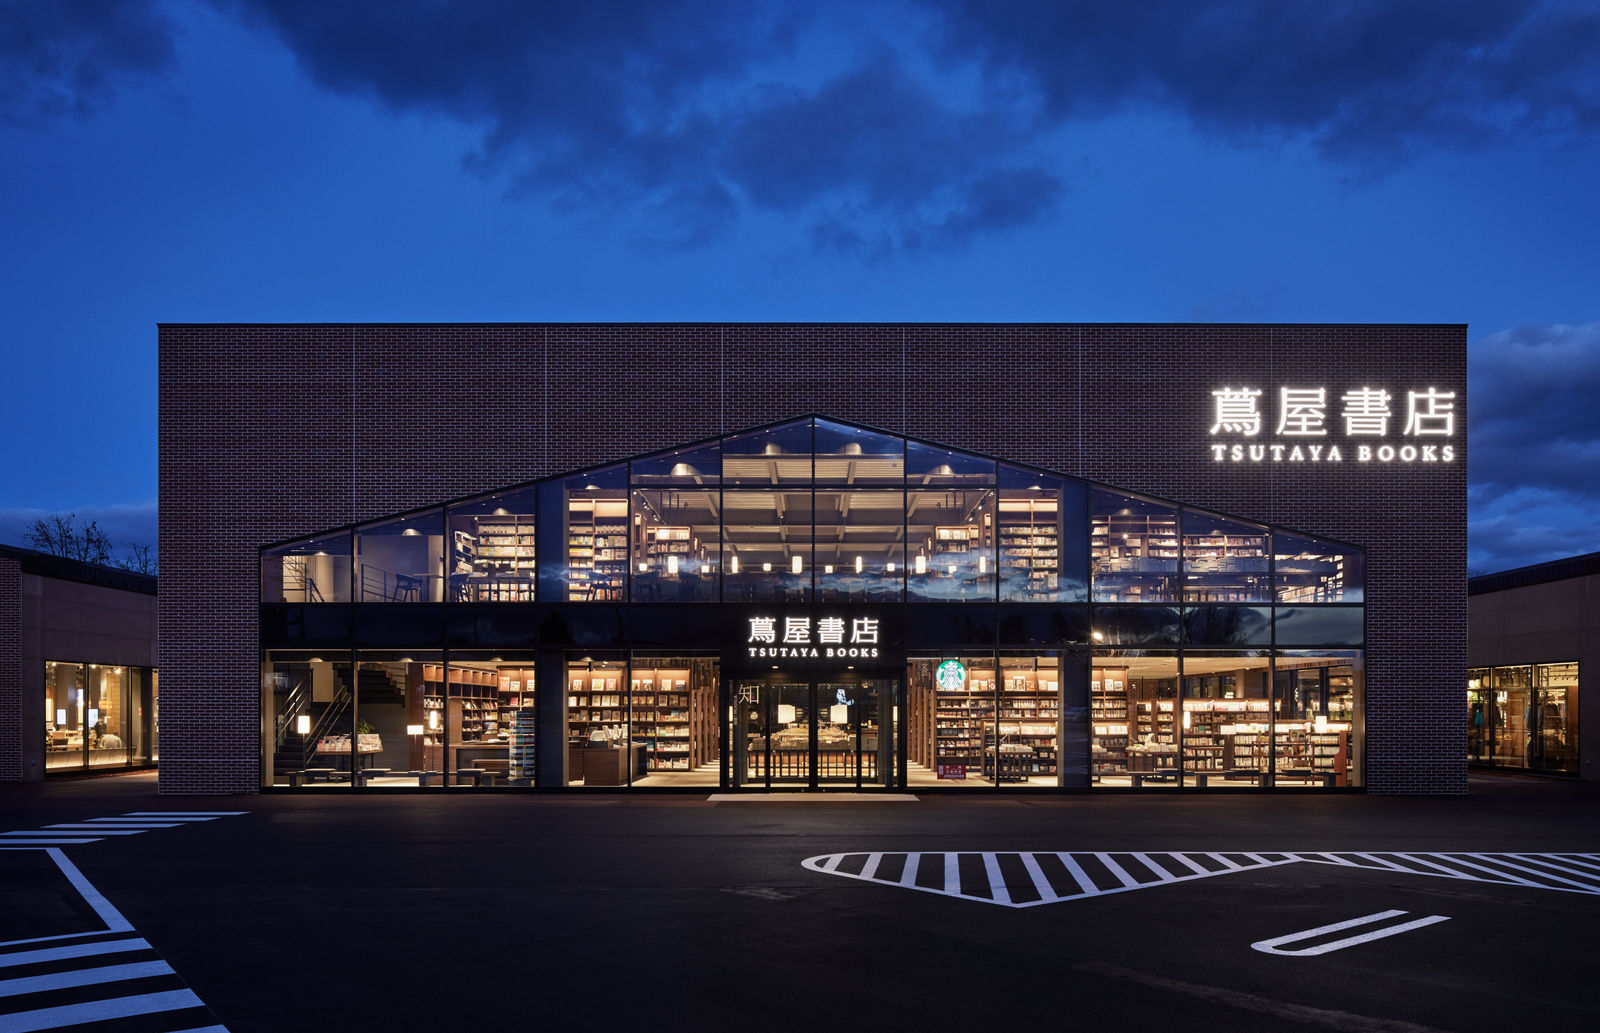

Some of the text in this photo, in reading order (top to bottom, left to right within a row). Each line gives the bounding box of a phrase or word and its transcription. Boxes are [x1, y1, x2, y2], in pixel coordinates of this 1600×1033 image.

[1210, 387, 1456, 437] 蔦屋書店
[1211, 445, 1455, 462] TSUTAYA BOOKS
[748, 616, 879, 644] 蔦屋書店
[748, 647, 879, 657] TSUTAYA BOOKS
[738, 684, 760, 704] 知
